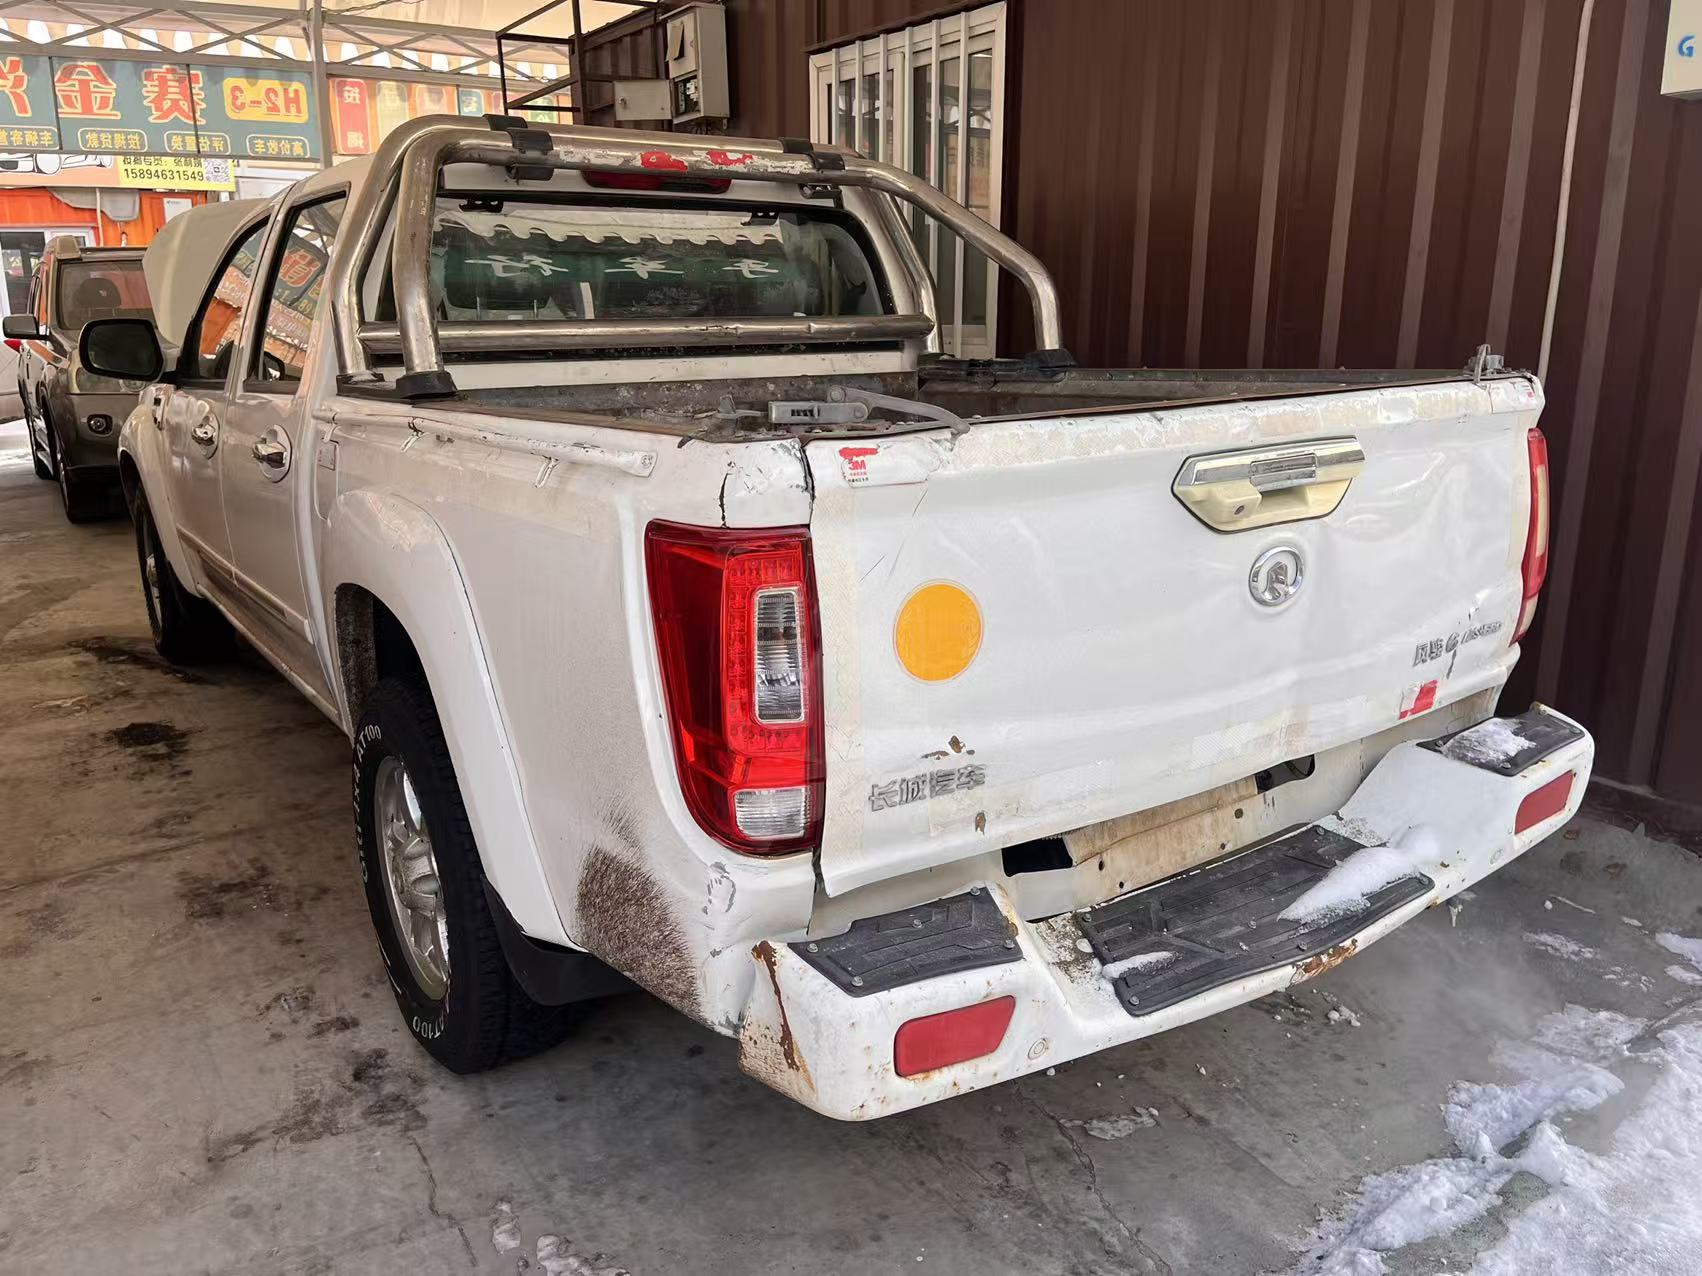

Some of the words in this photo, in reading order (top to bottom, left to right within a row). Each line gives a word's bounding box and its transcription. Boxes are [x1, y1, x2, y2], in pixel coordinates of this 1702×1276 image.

[124, 168, 204, 182] 15894631549
[848, 459, 867, 471] 3M
[355, 724, 382, 763] AT100
